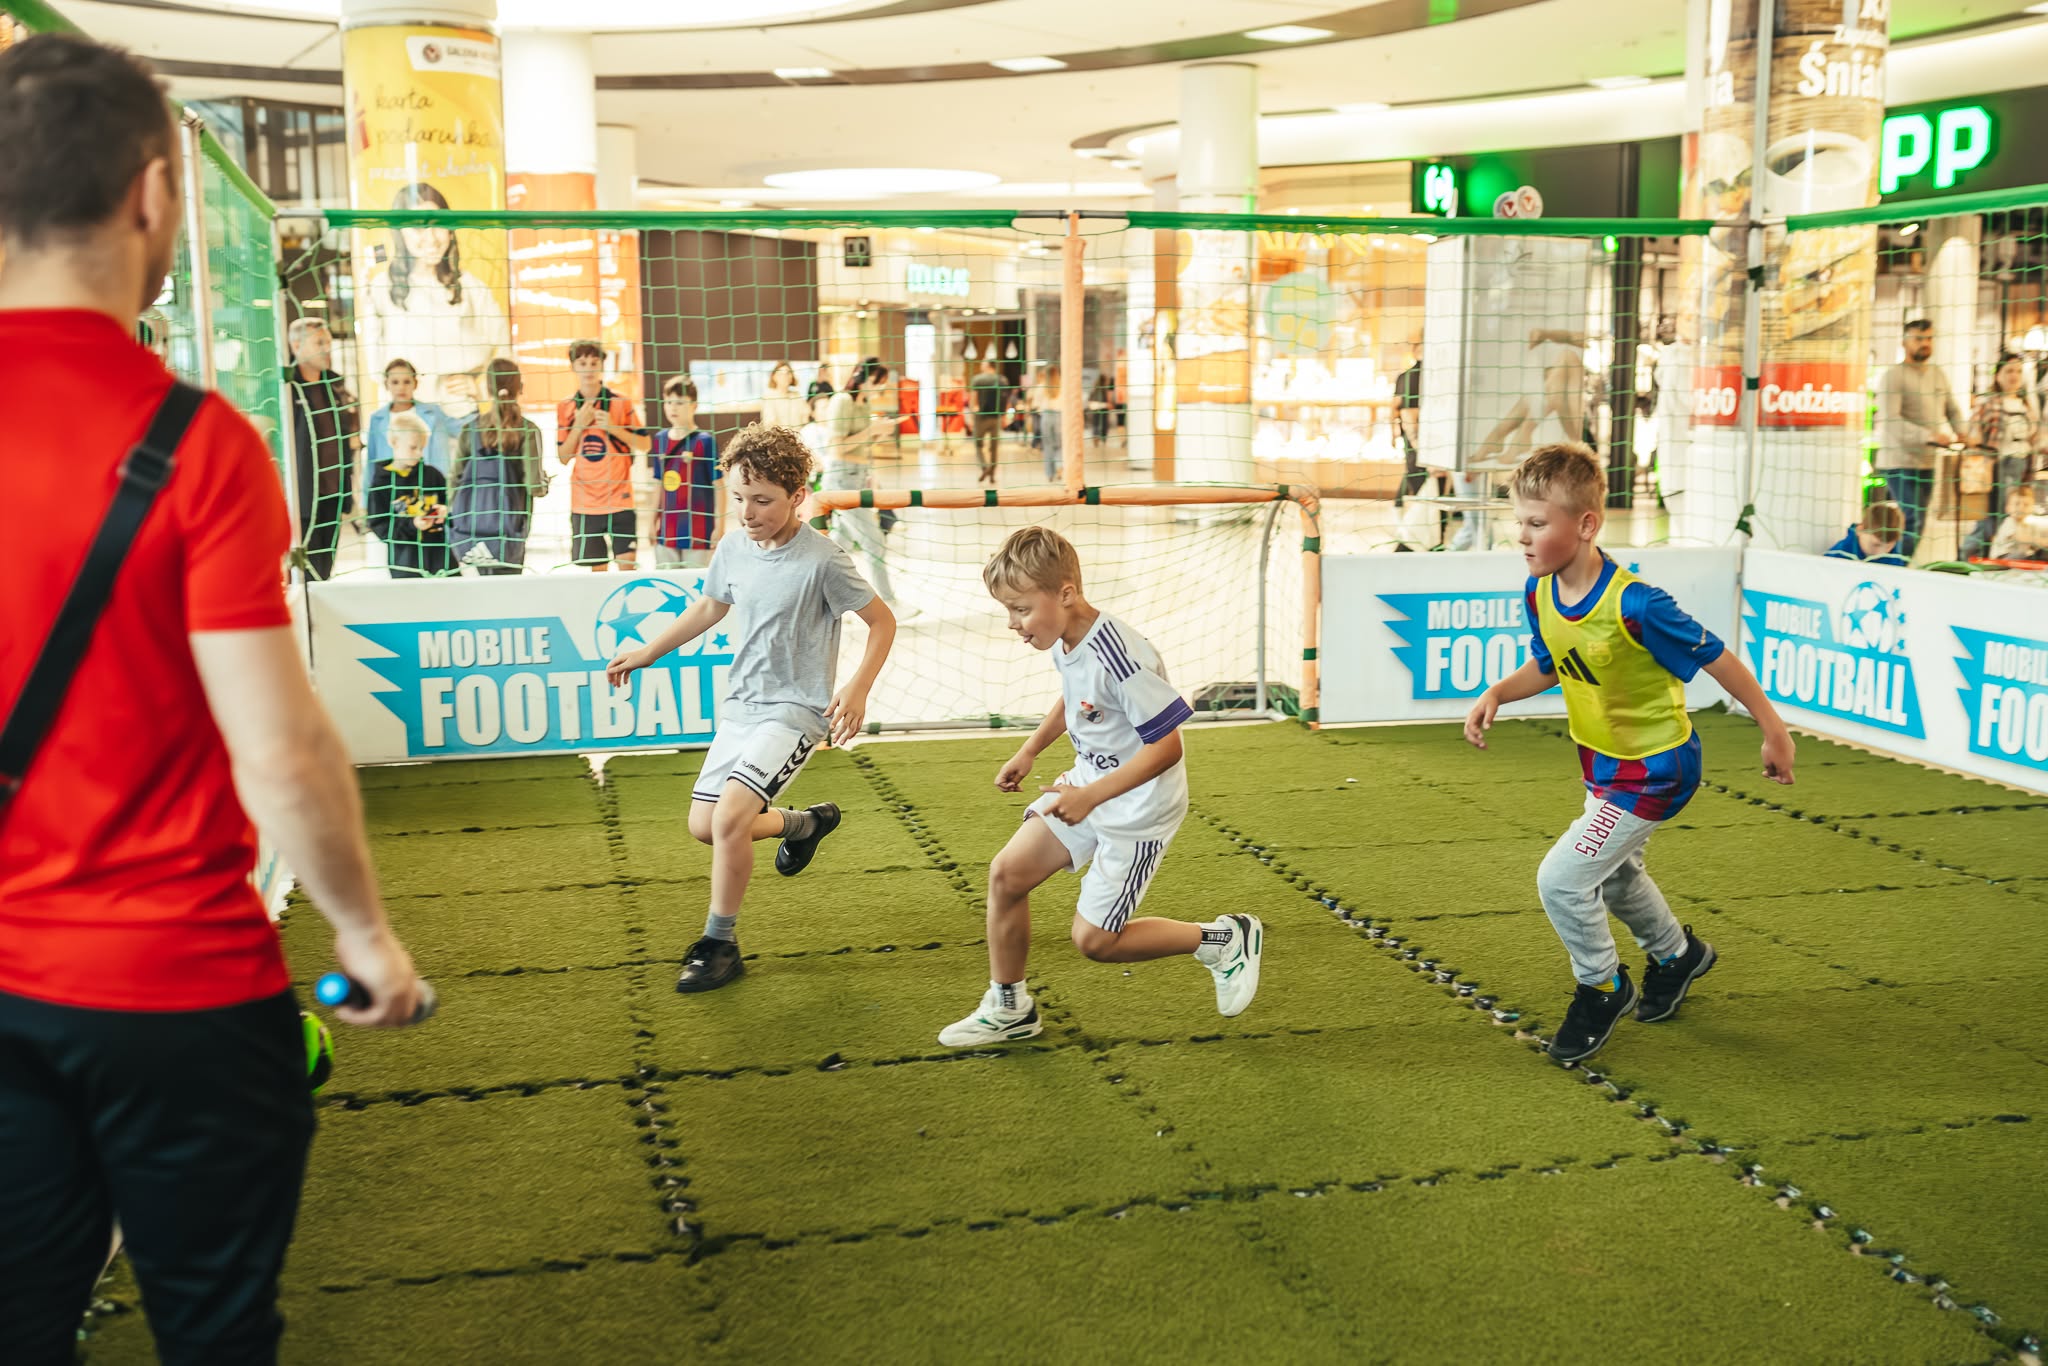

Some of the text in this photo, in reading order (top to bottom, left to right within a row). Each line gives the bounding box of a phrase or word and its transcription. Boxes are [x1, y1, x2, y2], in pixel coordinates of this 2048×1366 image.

[1427, 598, 1523, 630] MOBILE
[1765, 600, 1822, 640] MOBILE
[418, 627, 551, 668] MOBILE
[1762, 635, 1908, 727] FOOTBALL
